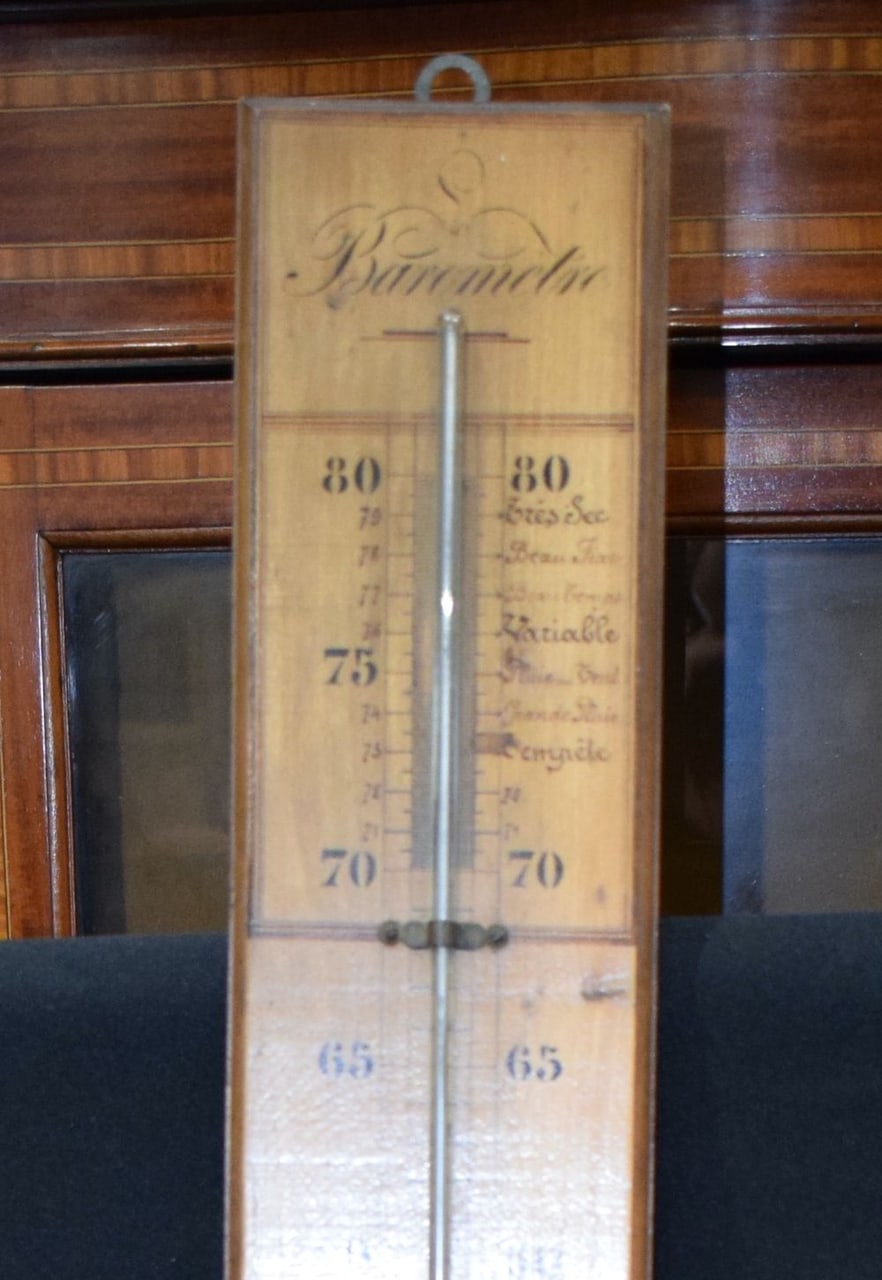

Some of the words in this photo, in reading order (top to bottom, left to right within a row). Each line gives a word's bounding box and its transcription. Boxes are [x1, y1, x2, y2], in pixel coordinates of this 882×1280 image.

[322, 457, 381, 494] 80
[511, 455, 570, 492] 80
[502, 612, 619, 643] Variable
[323, 648, 378, 687] 75
[321, 849, 377, 887] 70
[509, 850, 564, 888] 70
[318, 1042, 374, 1079] 65
[506, 1044, 563, 1081] 65
